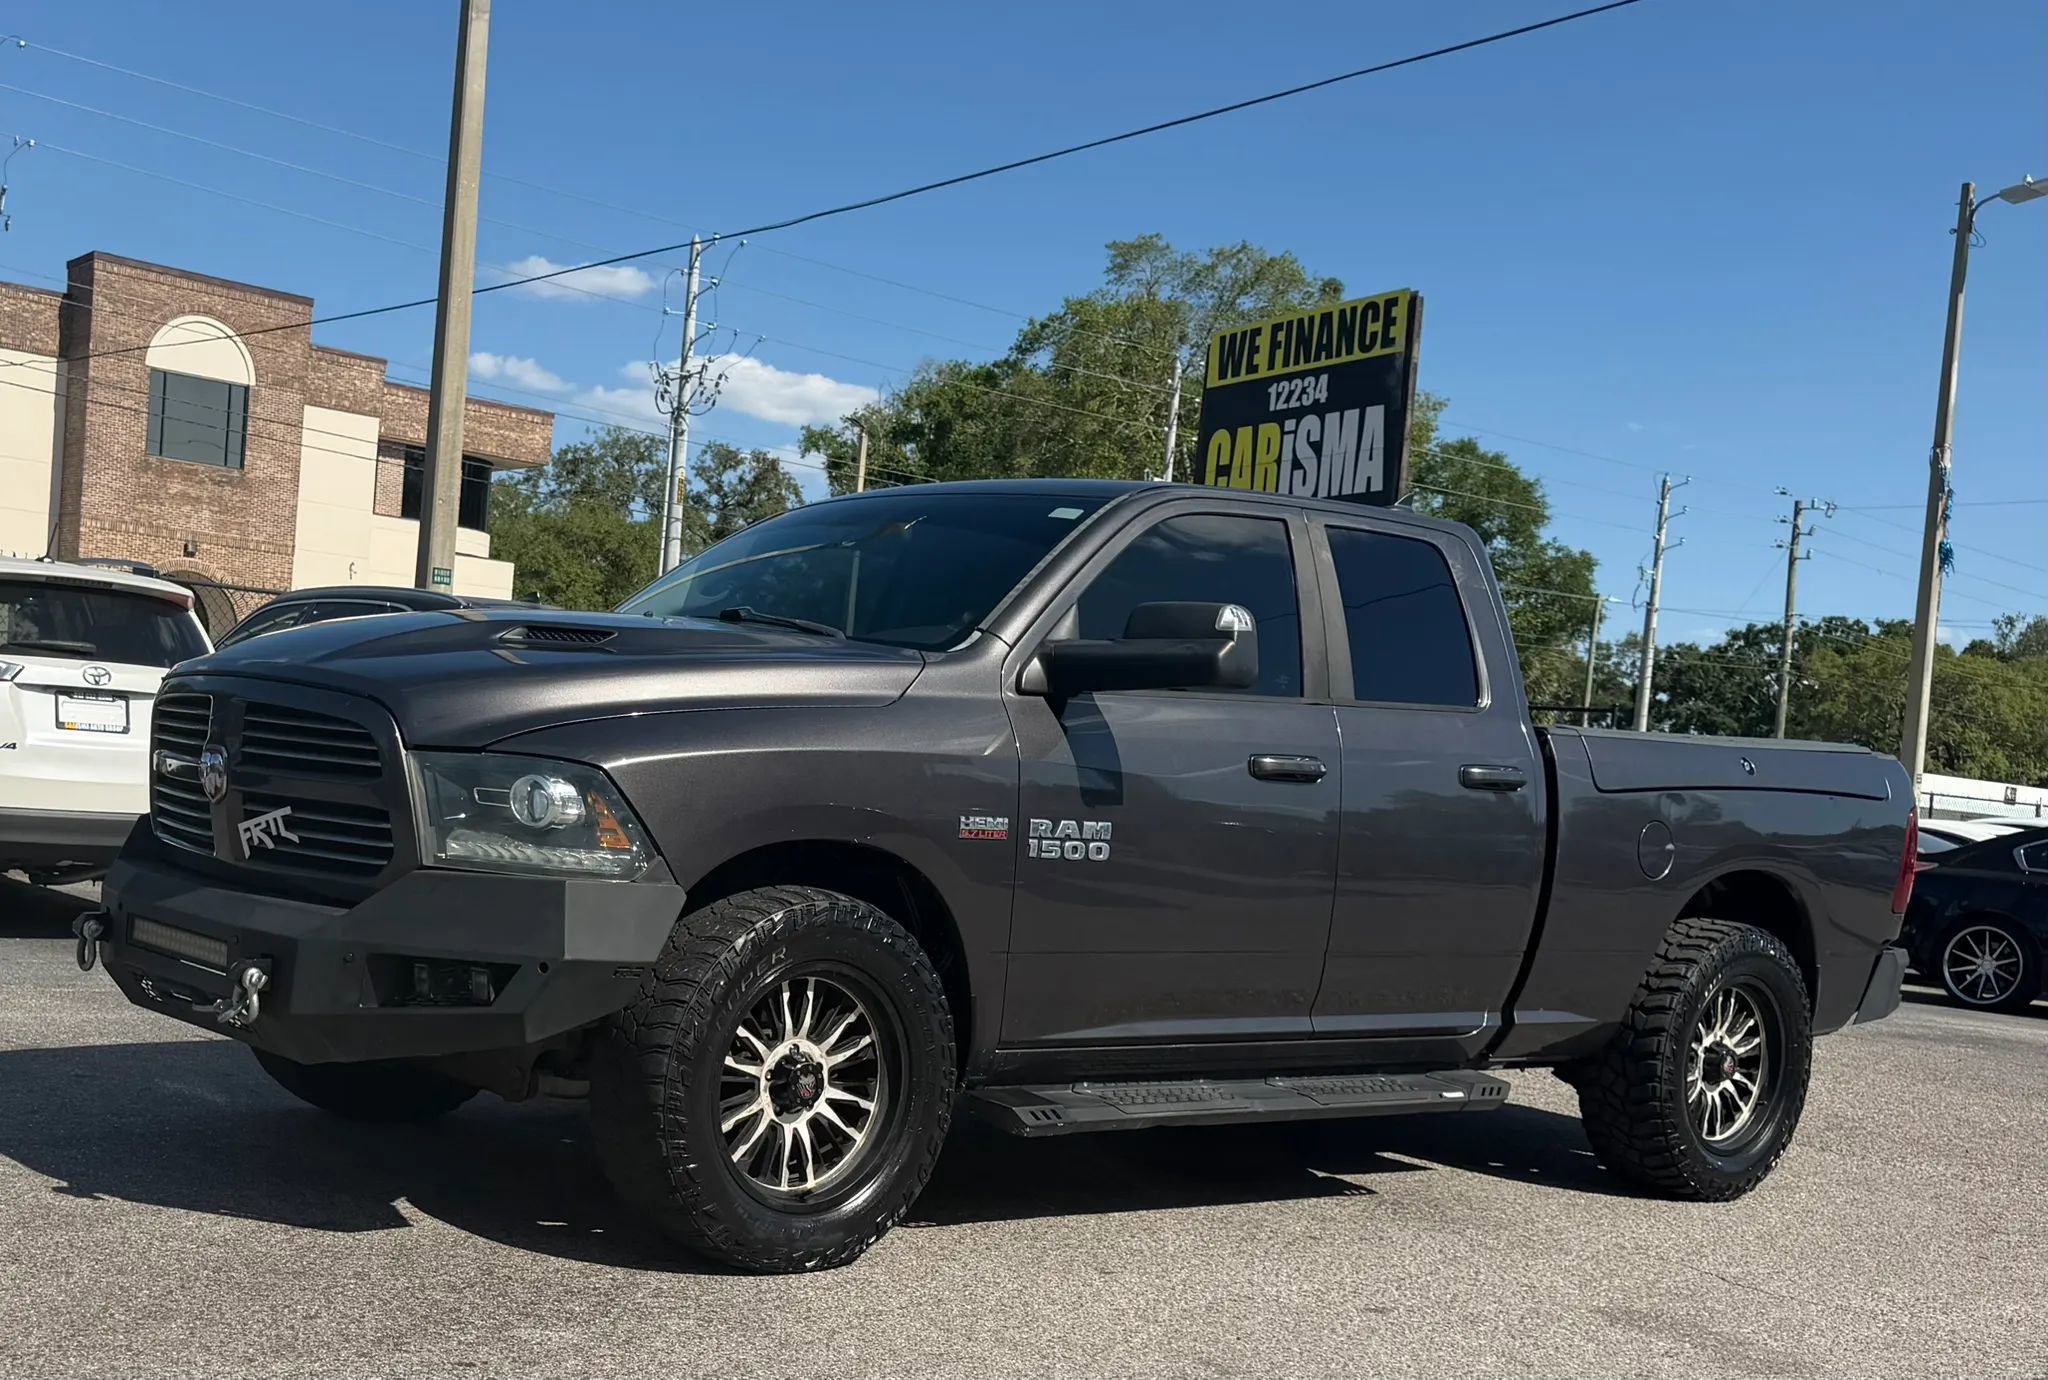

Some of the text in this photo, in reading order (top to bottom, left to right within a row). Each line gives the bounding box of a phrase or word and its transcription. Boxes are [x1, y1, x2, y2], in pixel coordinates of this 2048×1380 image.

[1218, 296, 1400, 381] WE FINANCE
[1267, 373, 1329, 412] 12234
[960, 815, 1009, 829] HEMI
[1029, 818, 1113, 841] RAM
[979, 830, 1006, 838] LITER
[1027, 838, 1111, 862] 1500
